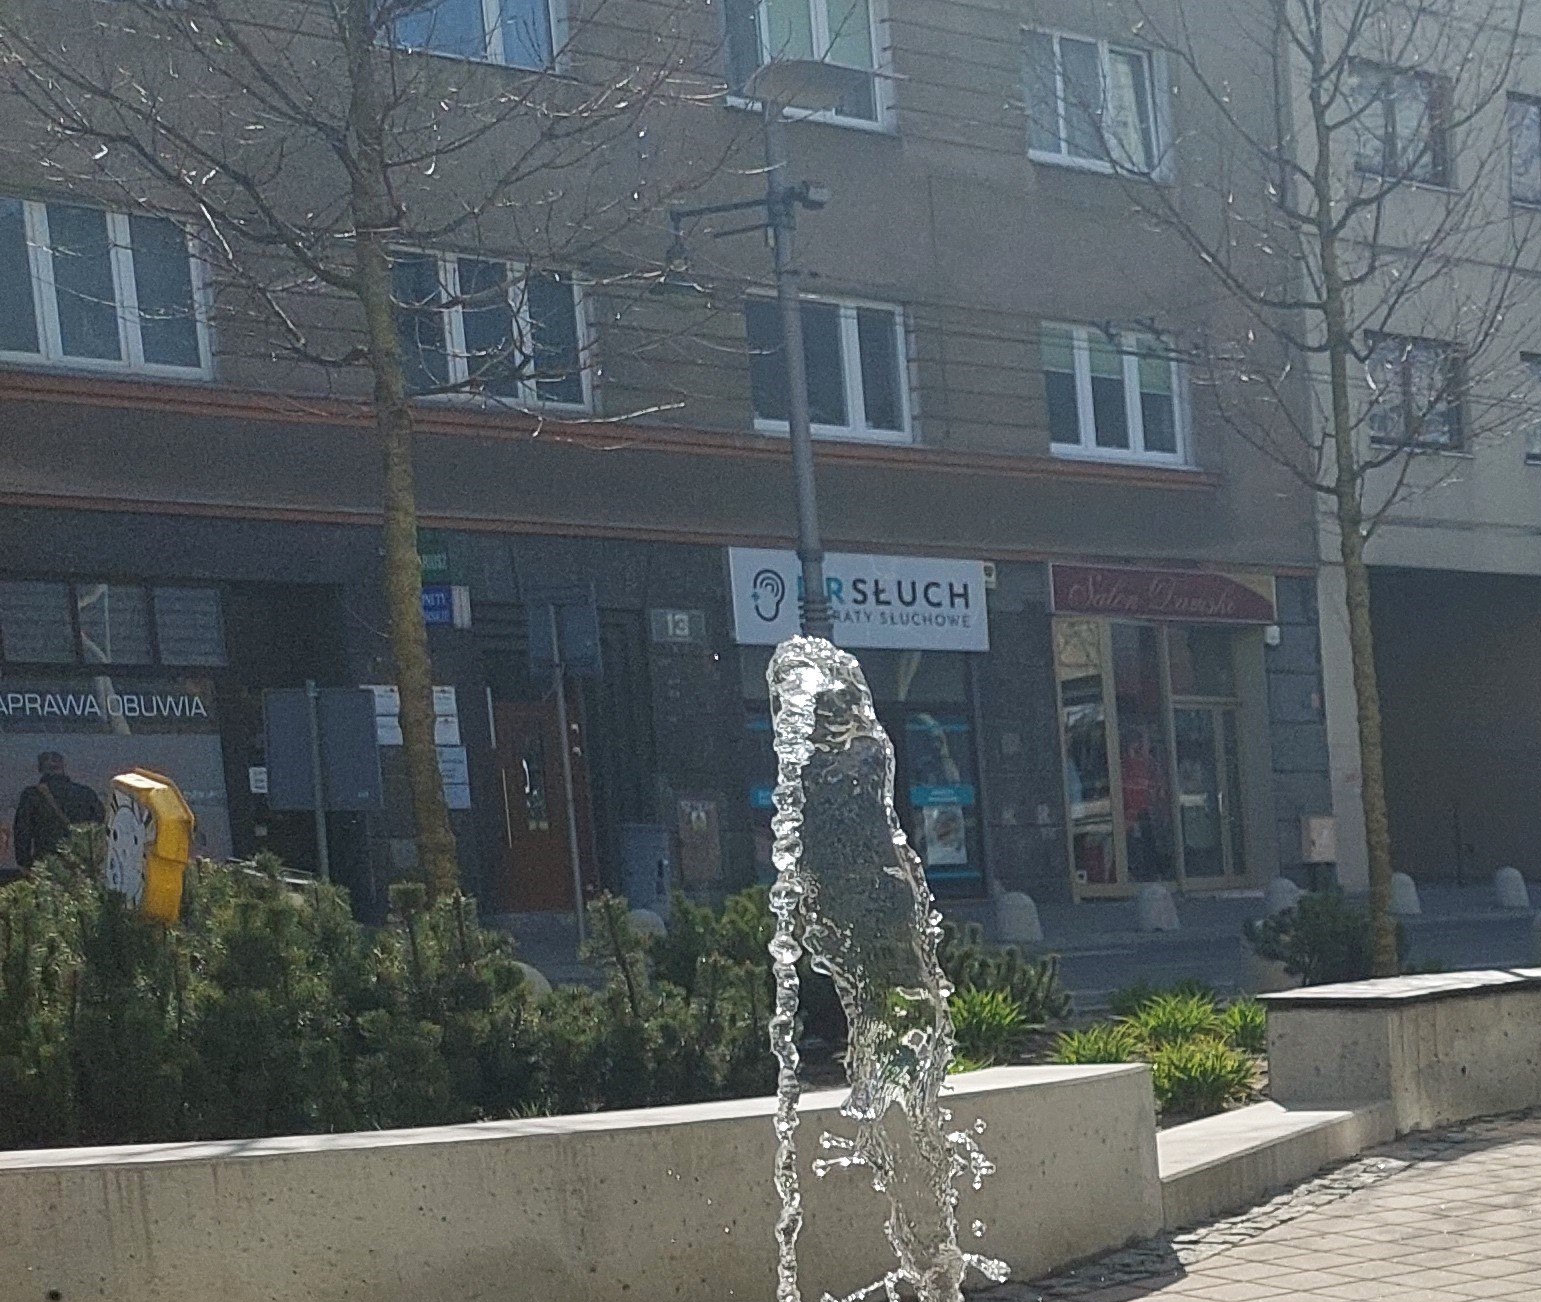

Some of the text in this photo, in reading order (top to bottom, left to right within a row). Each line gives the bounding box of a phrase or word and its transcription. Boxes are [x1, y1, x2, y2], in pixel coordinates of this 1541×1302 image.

[797, 576, 969, 609] RSŁUCH
[667, 613, 689, 635] 13
[880, 611, 971, 629] SŁUCHOWE
[106, 694, 208, 718] OBUWIA
